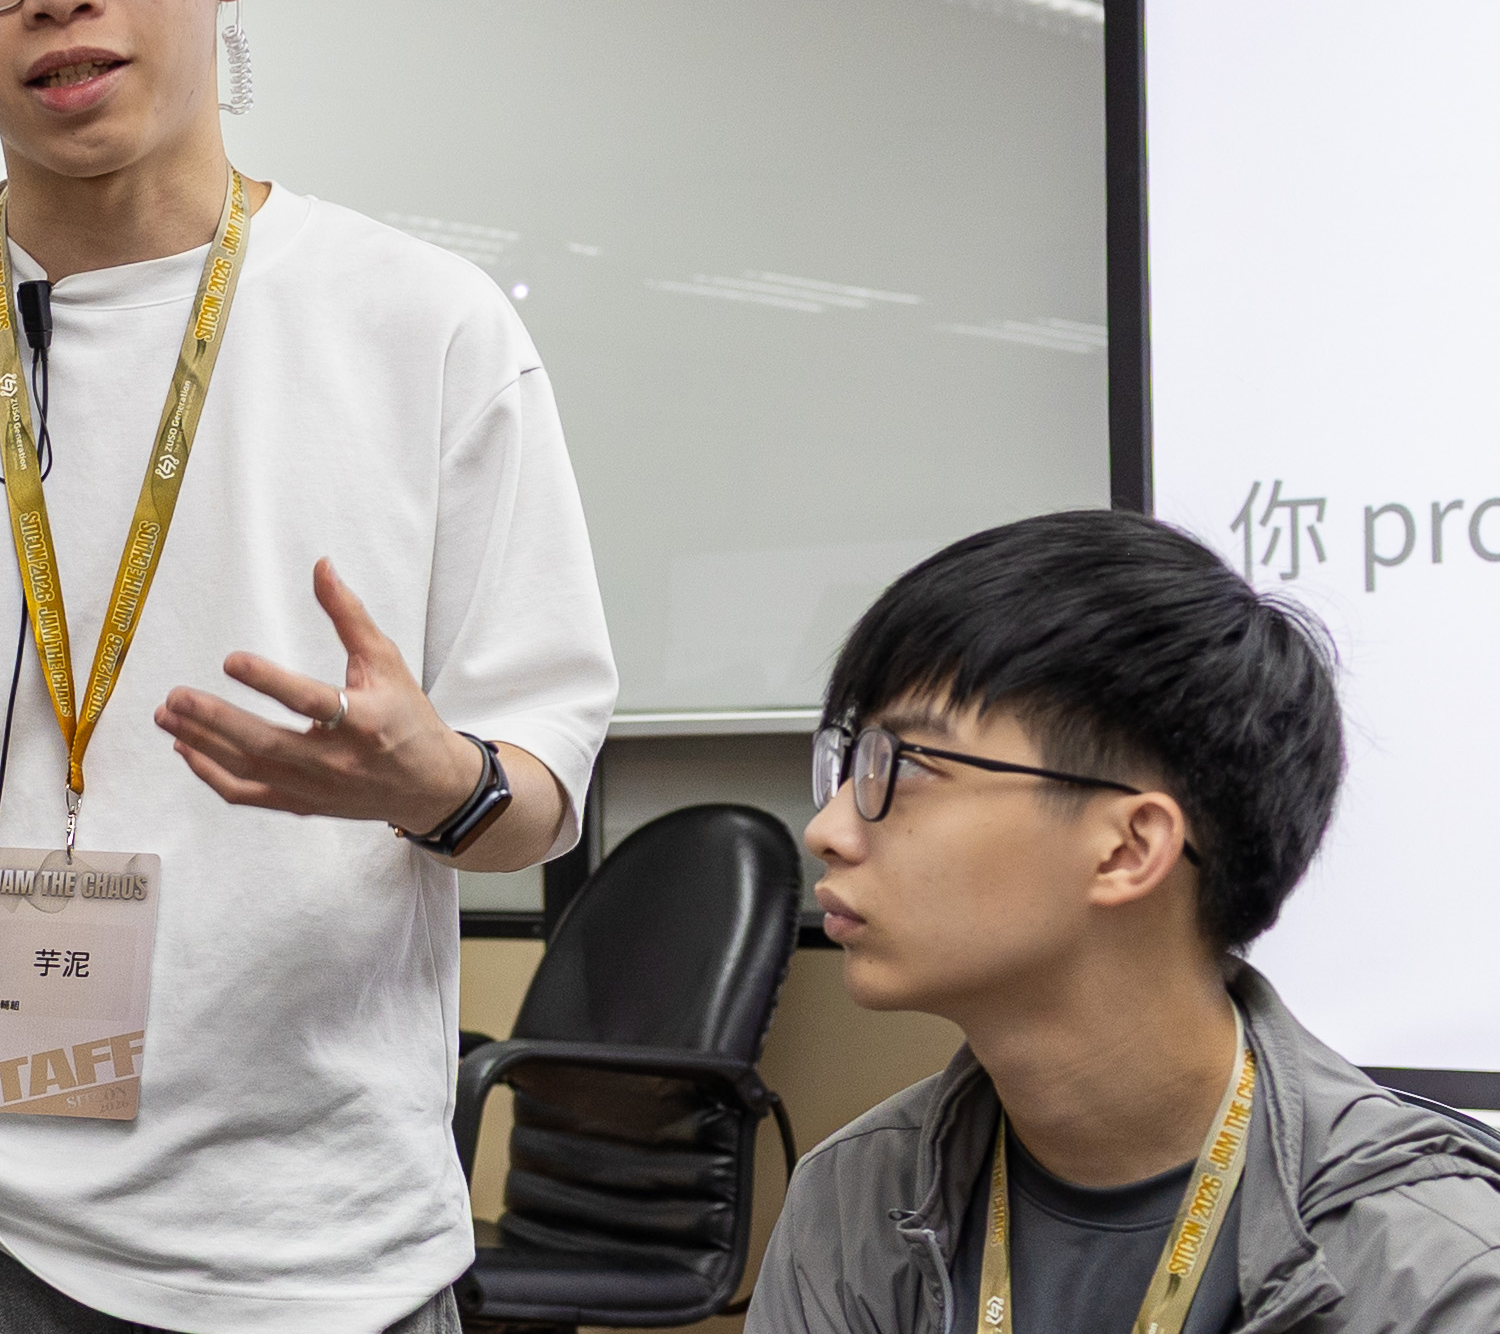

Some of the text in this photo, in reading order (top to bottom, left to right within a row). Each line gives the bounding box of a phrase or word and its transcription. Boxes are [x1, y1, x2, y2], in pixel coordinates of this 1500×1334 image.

[228, 199, 245, 226] THE
[220, 222, 243, 257] JAM
[207, 257, 233, 296] 2026
[194, 294, 224, 342] SITCON
[171, 380, 191, 428] Generation
[14, 420, 28, 471] Generation
[1229, 478, 1327, 583] 你
[20, 510, 73, 717] SITCON 2026 JAM THE CHAOS
[86, 520, 160, 723] SITCON 2026 JAM THE CHAOS
[40, 870, 76, 898] THE
[81, 871, 149, 901] CHAOS
[33, 948, 90, 978] 芋泥
[1223, 1100, 1251, 1131] THE
[1209, 1129, 1242, 1171] JAM
[1188, 1172, 1223, 1222] 2026
[1166, 1219, 1207, 1279] SITCON
